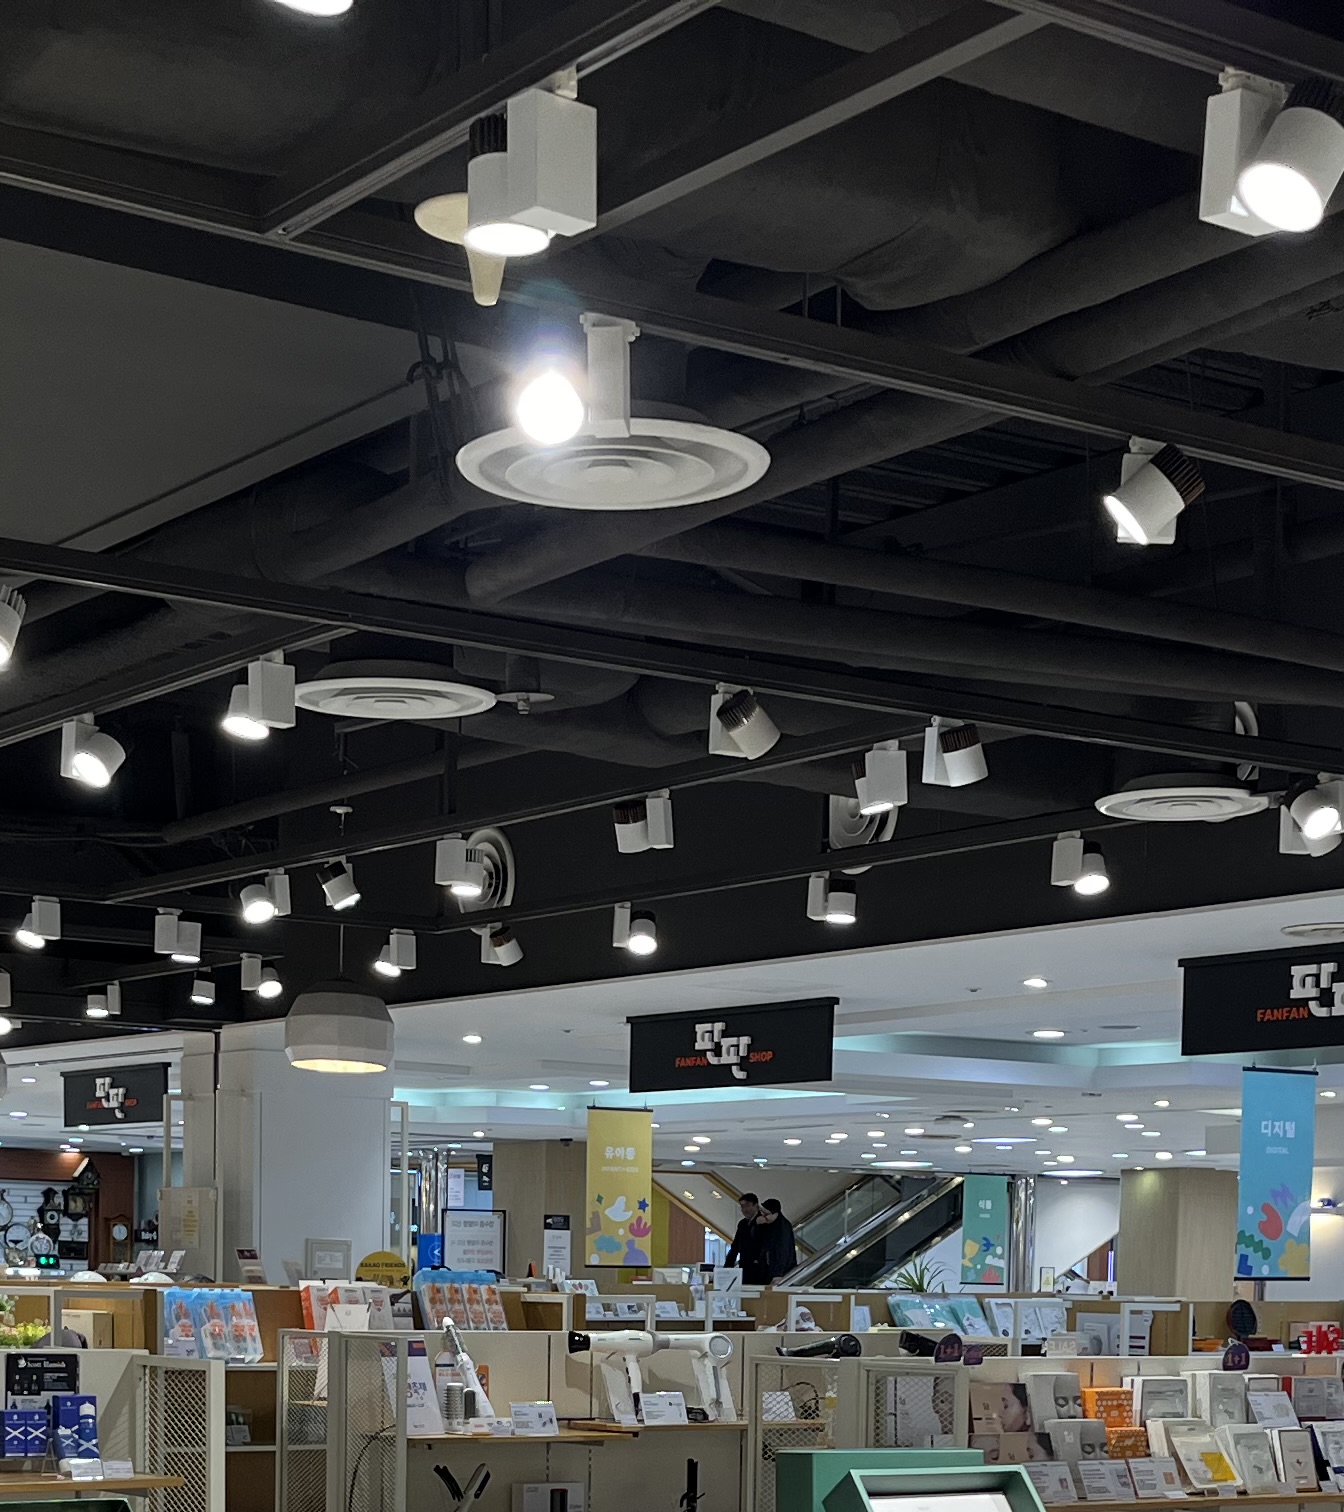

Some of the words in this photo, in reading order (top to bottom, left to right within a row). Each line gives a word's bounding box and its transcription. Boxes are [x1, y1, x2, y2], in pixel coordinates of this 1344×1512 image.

[1256, 1007, 1308, 1022] FANFAN
[675, 1057, 707, 1068] FANFAN
[748, 1051, 774, 1063] SHOP
[1261, 1120, 1295, 1138] 디지털
[604, 1146, 636, 1161] 유아동
[1226, 1353, 1246, 1366] 1+1
